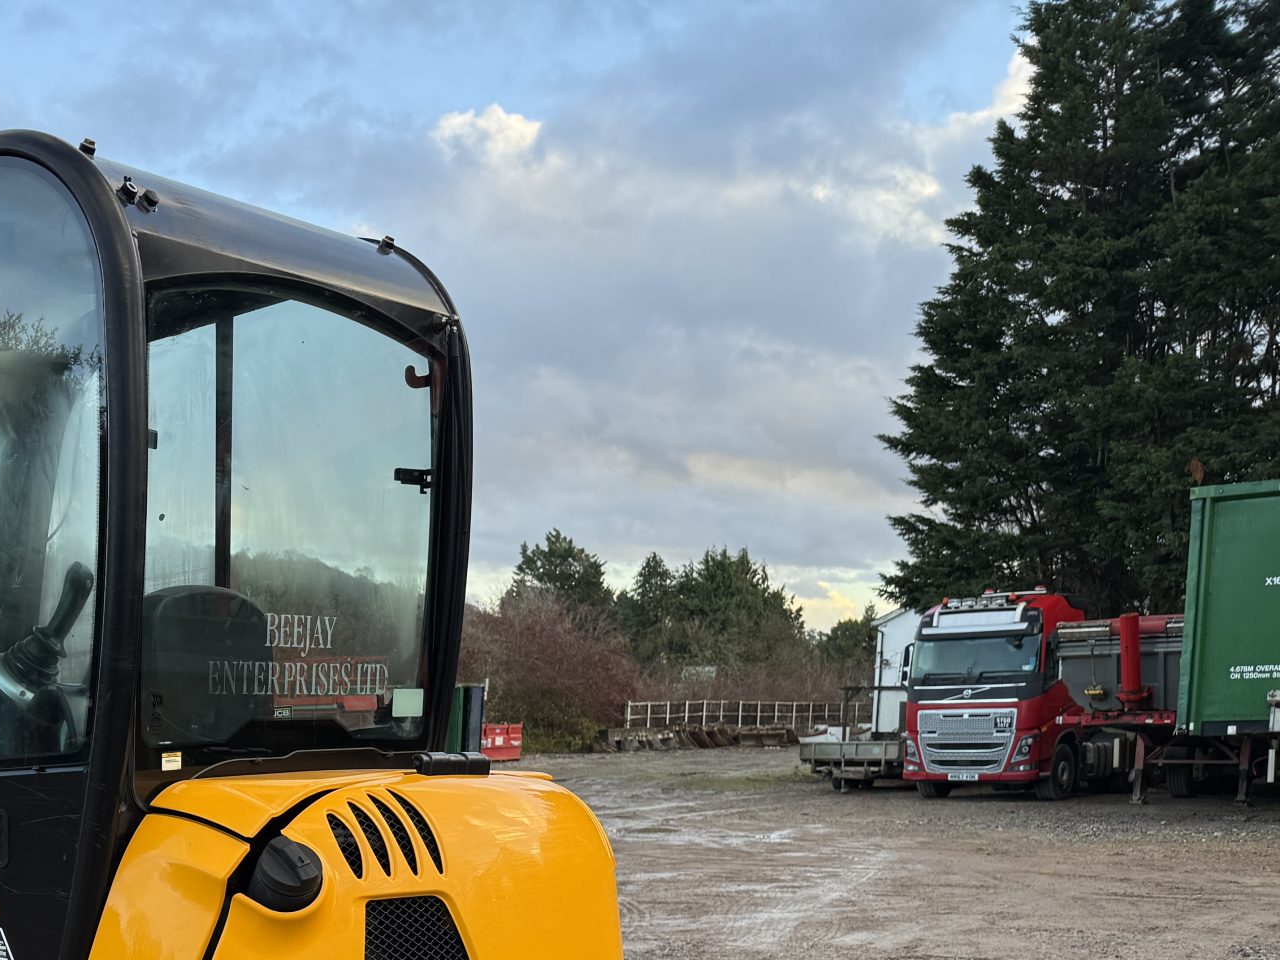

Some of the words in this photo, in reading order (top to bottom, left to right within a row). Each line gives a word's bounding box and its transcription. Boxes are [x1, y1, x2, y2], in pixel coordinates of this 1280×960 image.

[264, 612, 337, 657] BEEJAY
[208, 660, 352, 696] ENTERPRISES
[357, 663, 389, 696] LTD
[1230, 672, 1241, 680] ON
